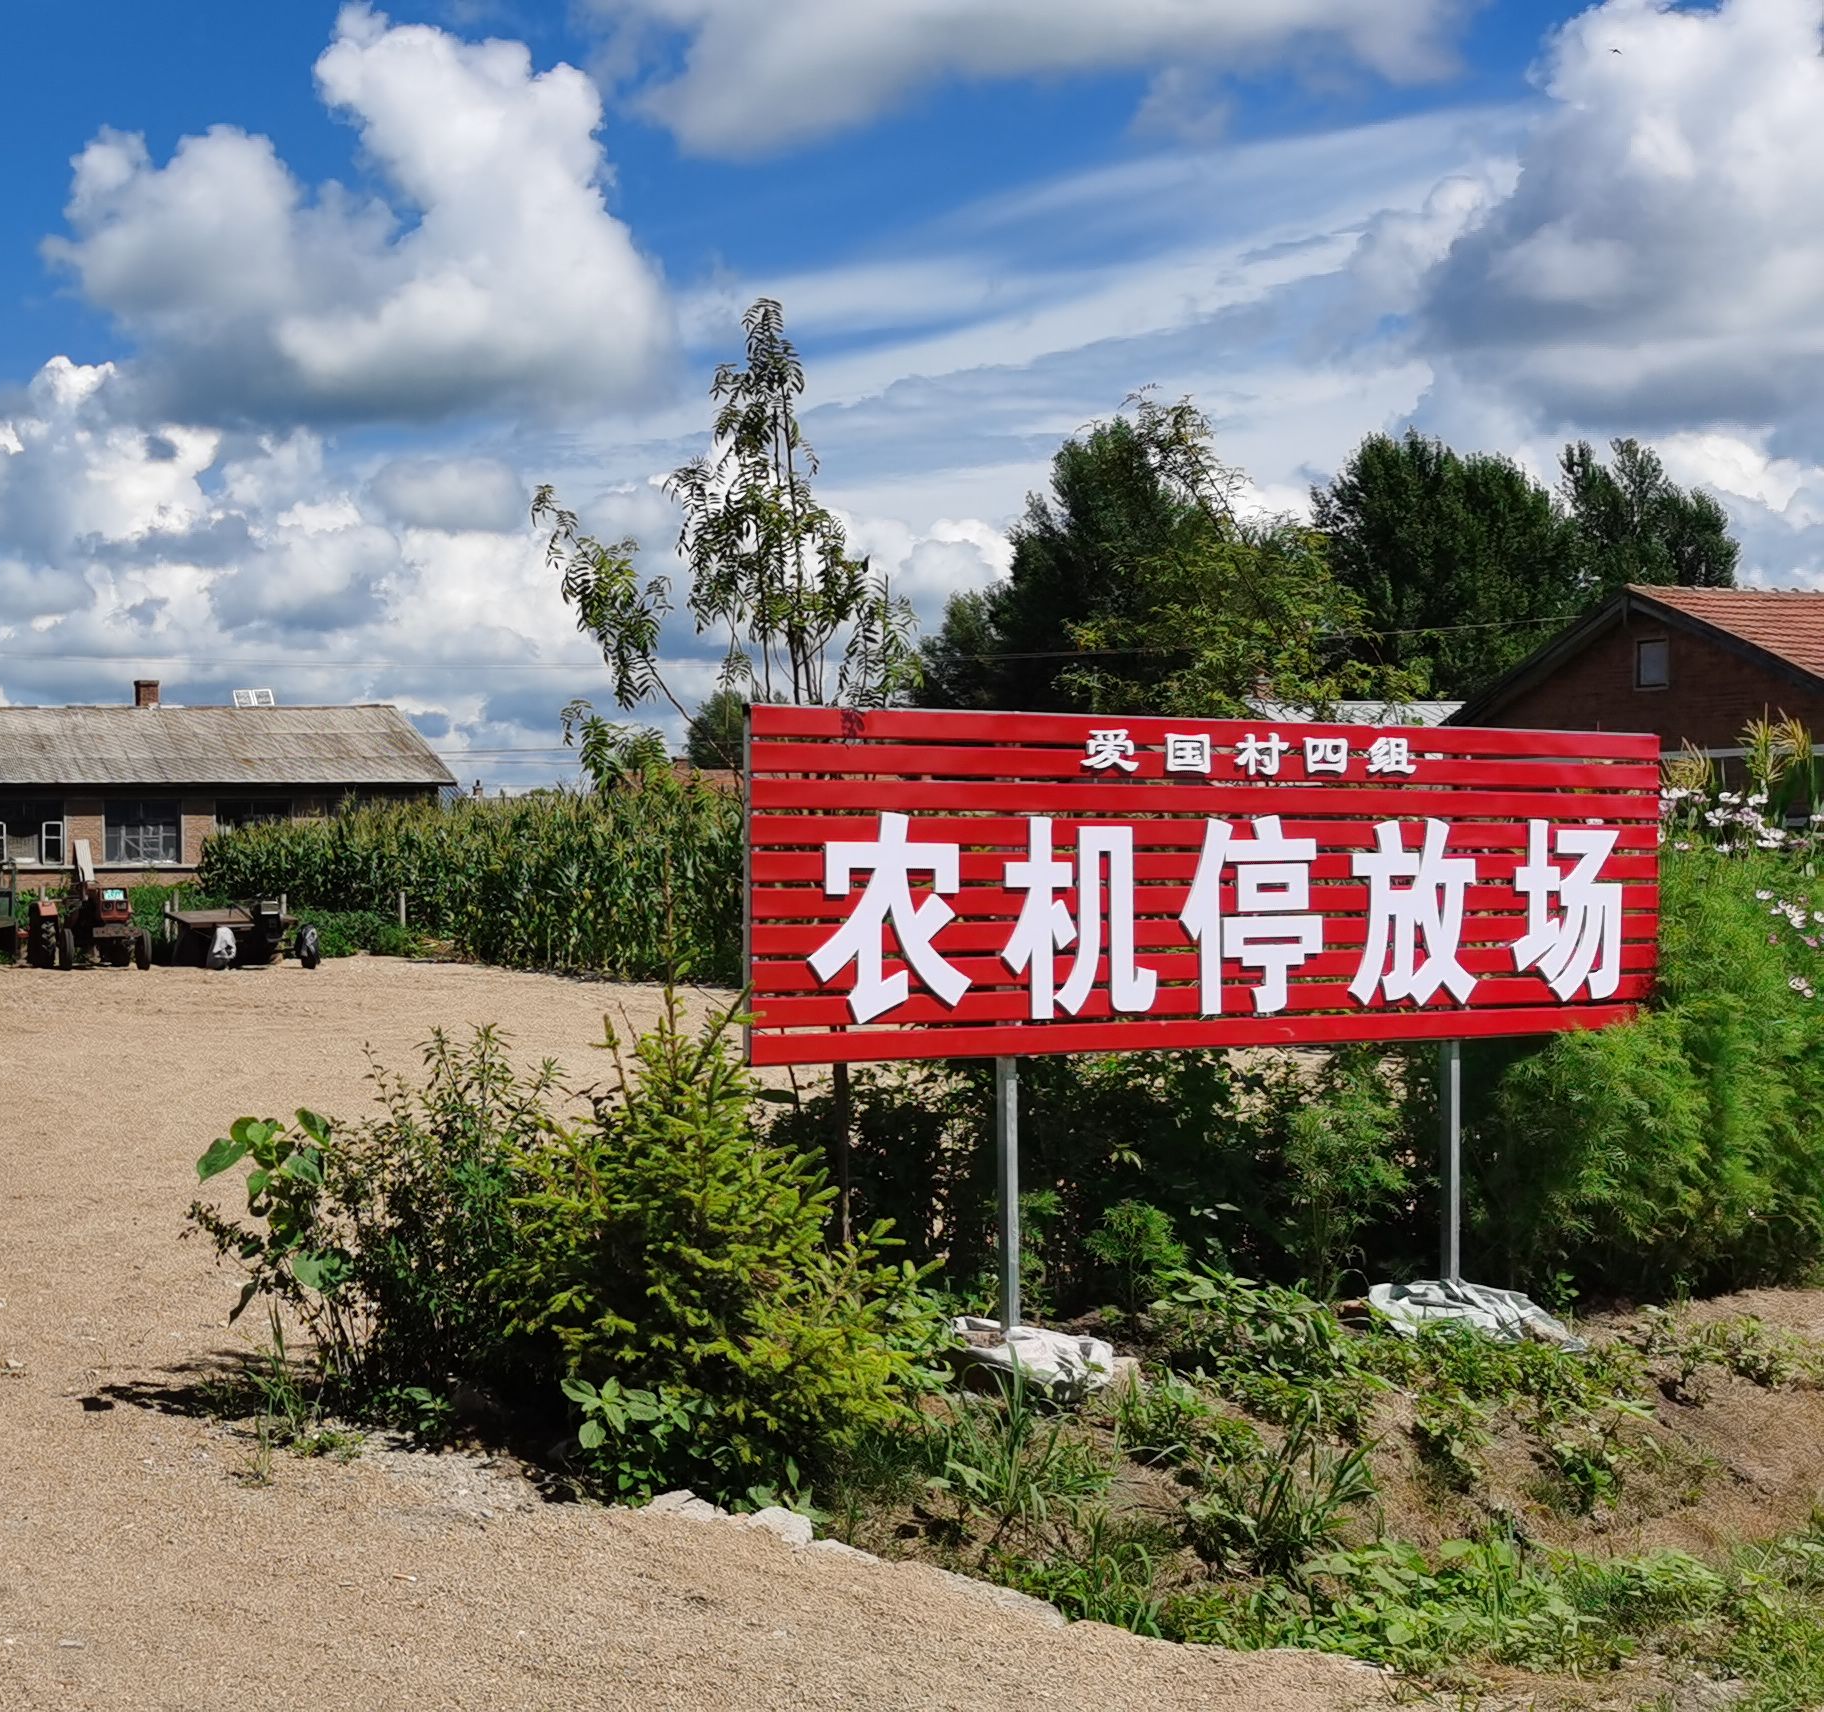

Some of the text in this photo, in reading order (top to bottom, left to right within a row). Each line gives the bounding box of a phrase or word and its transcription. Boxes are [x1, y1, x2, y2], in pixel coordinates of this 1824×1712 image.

[1081, 729, 1417, 776] 爱国村四组
[807, 812, 1623, 1024] 农机停放场
